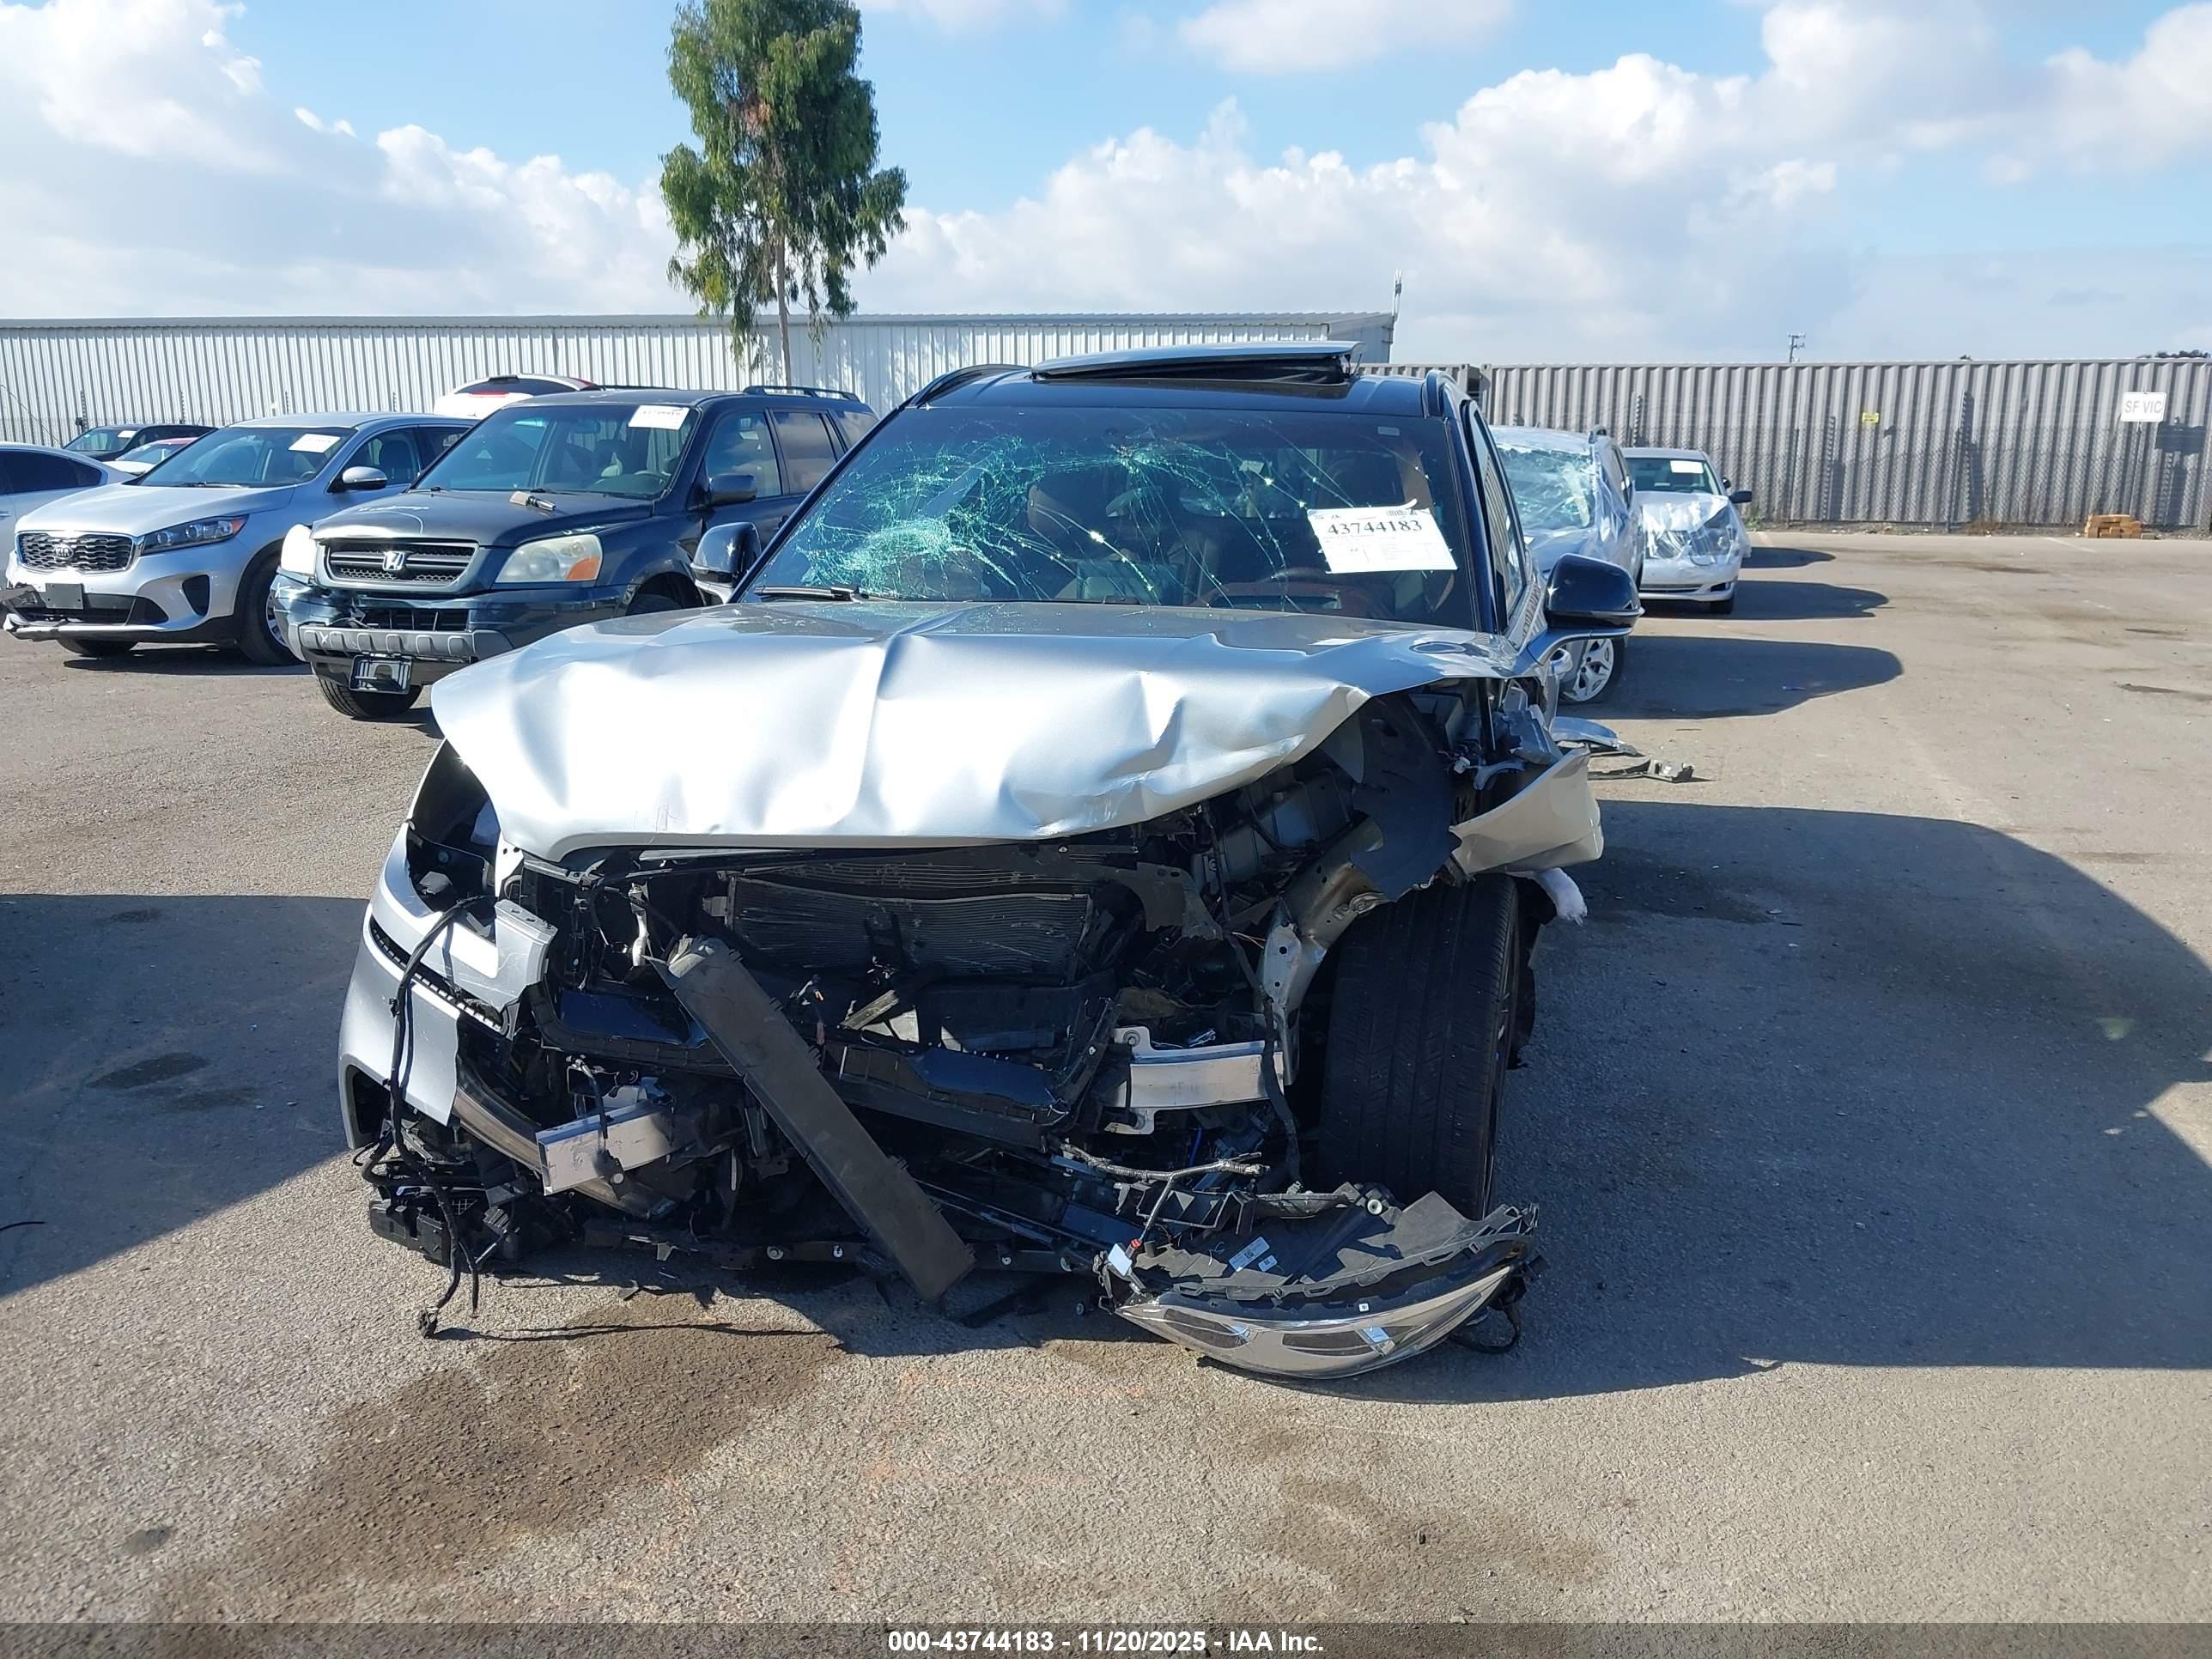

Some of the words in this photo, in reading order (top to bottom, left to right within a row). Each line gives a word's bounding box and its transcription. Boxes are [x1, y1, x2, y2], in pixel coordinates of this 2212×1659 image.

[2124, 400, 2140, 413] SF
[2143, 400, 2162, 413] VIC
[1328, 520, 1422, 535] 43744183
[55, 548, 70, 556] KIA
